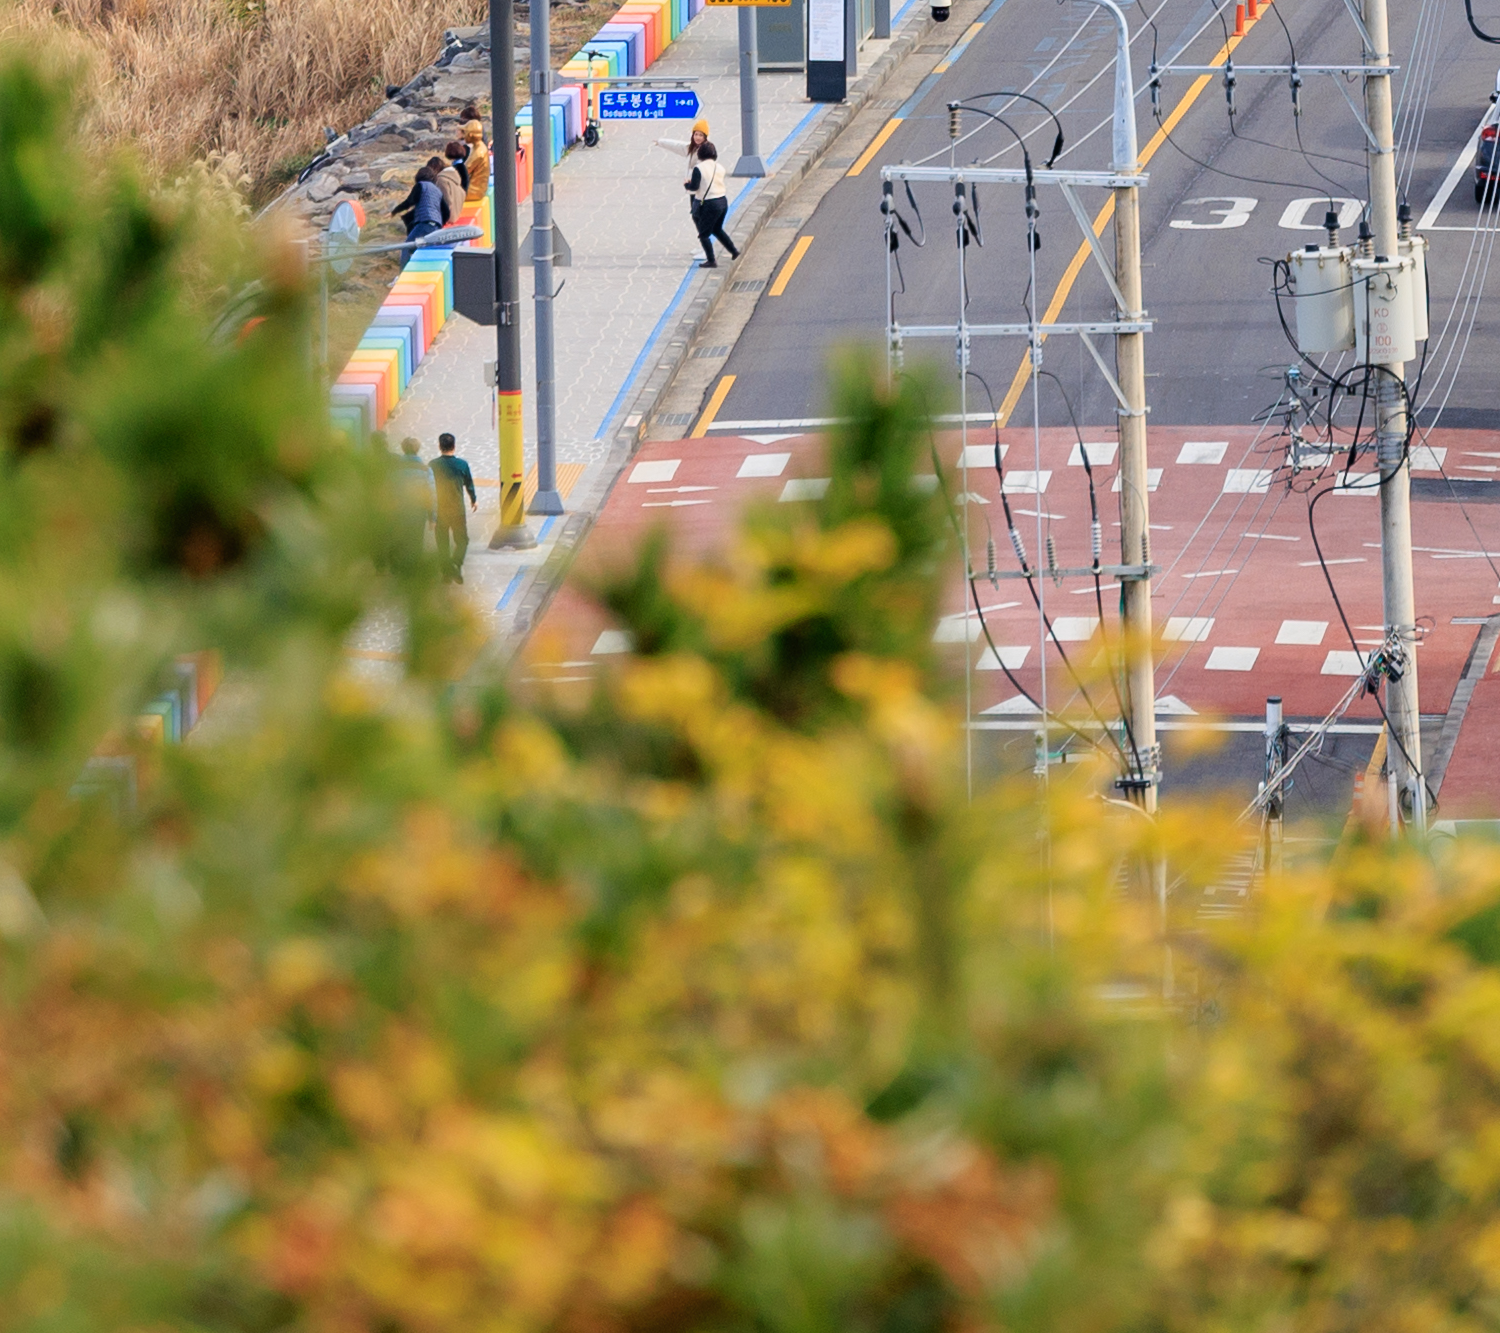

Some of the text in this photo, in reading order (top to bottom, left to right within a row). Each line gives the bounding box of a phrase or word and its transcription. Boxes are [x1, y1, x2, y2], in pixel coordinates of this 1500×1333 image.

[602, 109, 643, 119] Dodubong
[1169, 196, 1366, 230] 30
[1373, 308, 1389, 318] KD
[1375, 336, 1392, 346] 100
